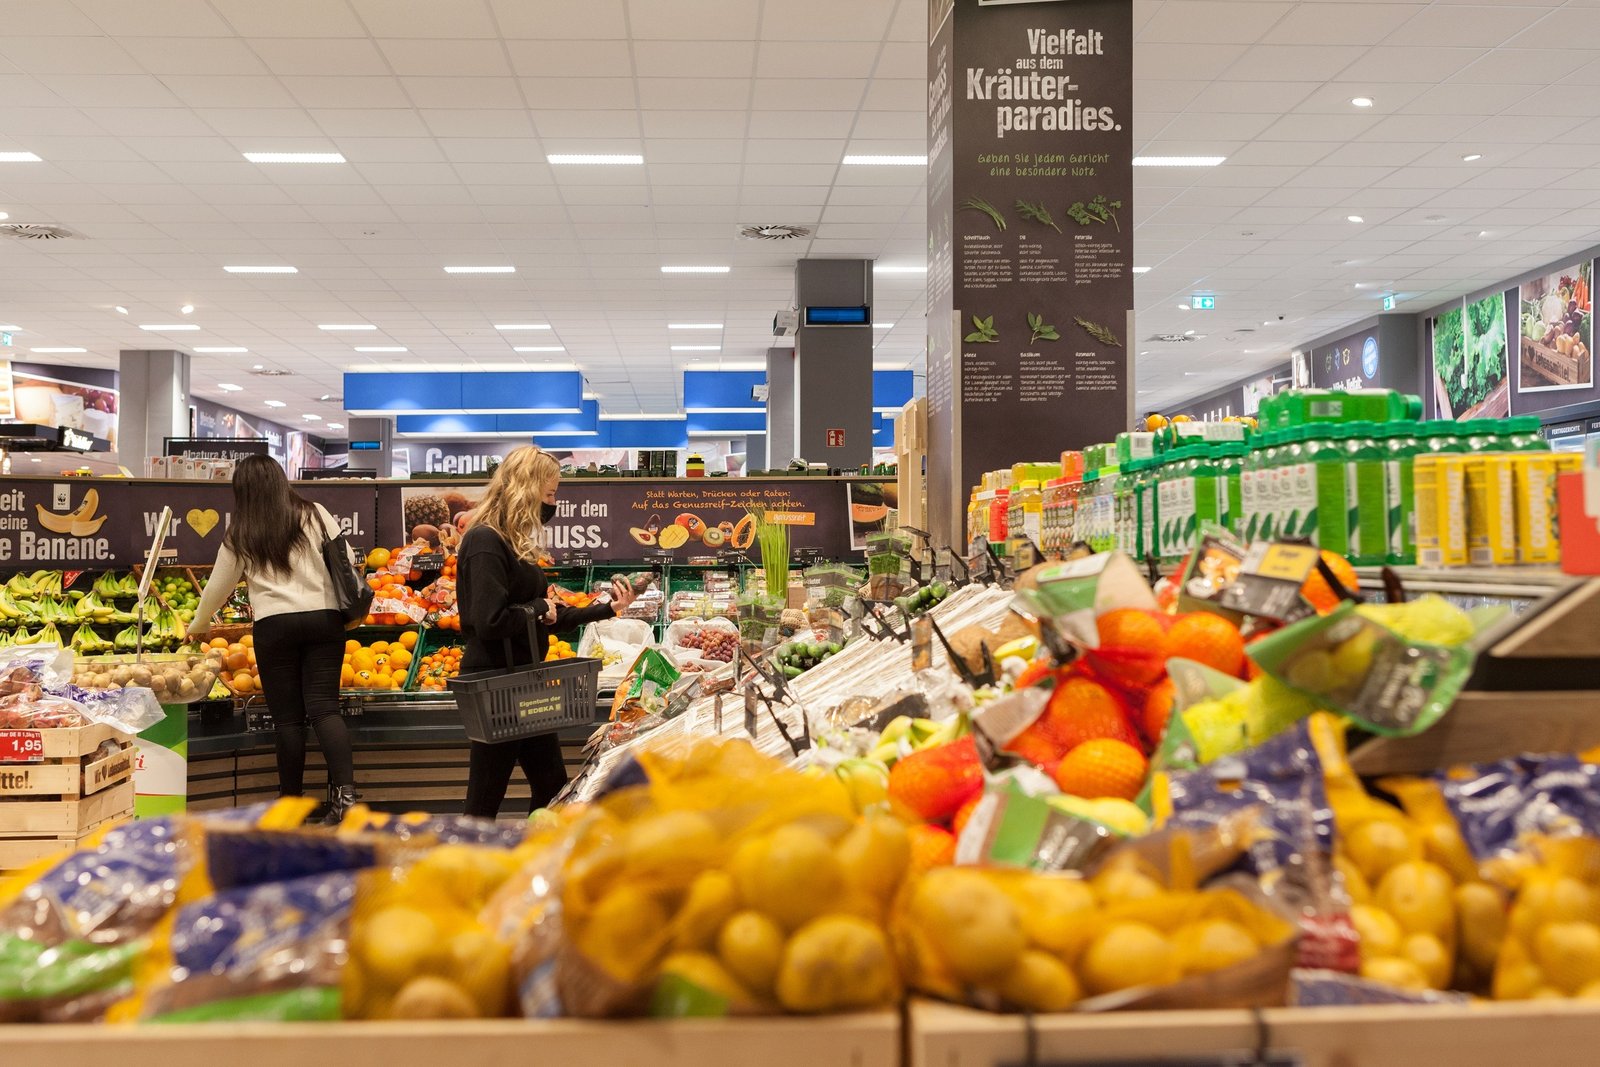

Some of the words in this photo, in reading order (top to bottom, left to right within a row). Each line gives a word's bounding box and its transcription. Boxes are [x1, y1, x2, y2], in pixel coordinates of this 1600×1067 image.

[1027, 28, 1103, 55] Vielfalt
[1016, 58, 1036, 69] aus
[1040, 56, 1063, 69] dem
[967, 68, 1079, 100] Kräuter-
[997, 99, 1122, 138] paradies.
[978, 154, 1010, 163] Geben
[1033, 154, 1065, 167] jedem
[1069, 153, 1110, 163] Gericht
[990, 167, 1011, 176] eine
[1015, 167, 1067, 176] besondere
[646, 490, 665, 498] Statt
[668, 490, 699, 499] Warten,
[702, 489, 737, 498] Drücken
[740, 489, 761, 498] oder
[764, 489, 791, 498] Raten:
[555, 499, 577, 518] für
[581, 499, 608, 518] den
[632, 500, 649, 510] Auf
[652, 499, 670, 509] das
[20, 531, 116, 561] Banane.
[528, 705, 554, 714] EDEKA
[12, 739, 42, 754] 1,95
